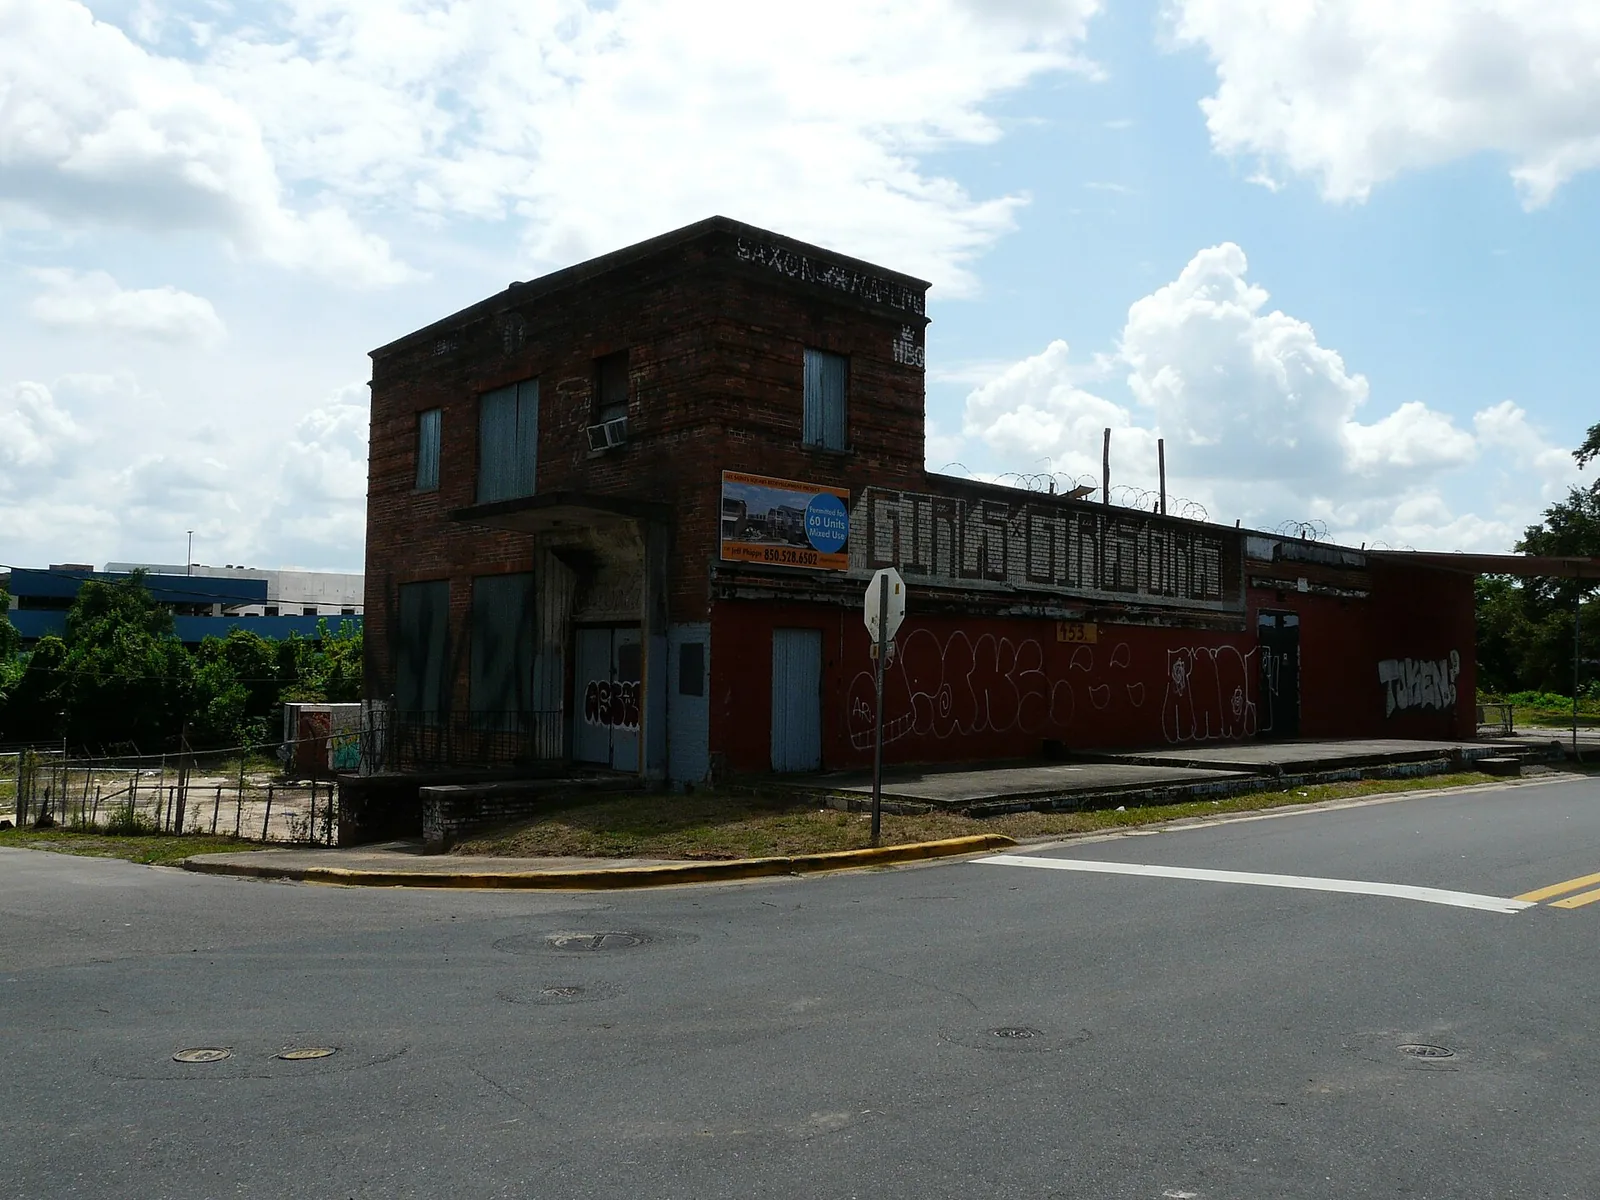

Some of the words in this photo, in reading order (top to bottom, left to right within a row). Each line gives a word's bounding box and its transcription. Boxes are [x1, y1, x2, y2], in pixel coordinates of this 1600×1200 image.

[809, 515, 821, 526] 60
[823, 517, 845, 530] Units
[809, 528, 830, 538] Mixed
[832, 530, 845, 540] Use
[764, 548, 818, 565] 850.528.6502
